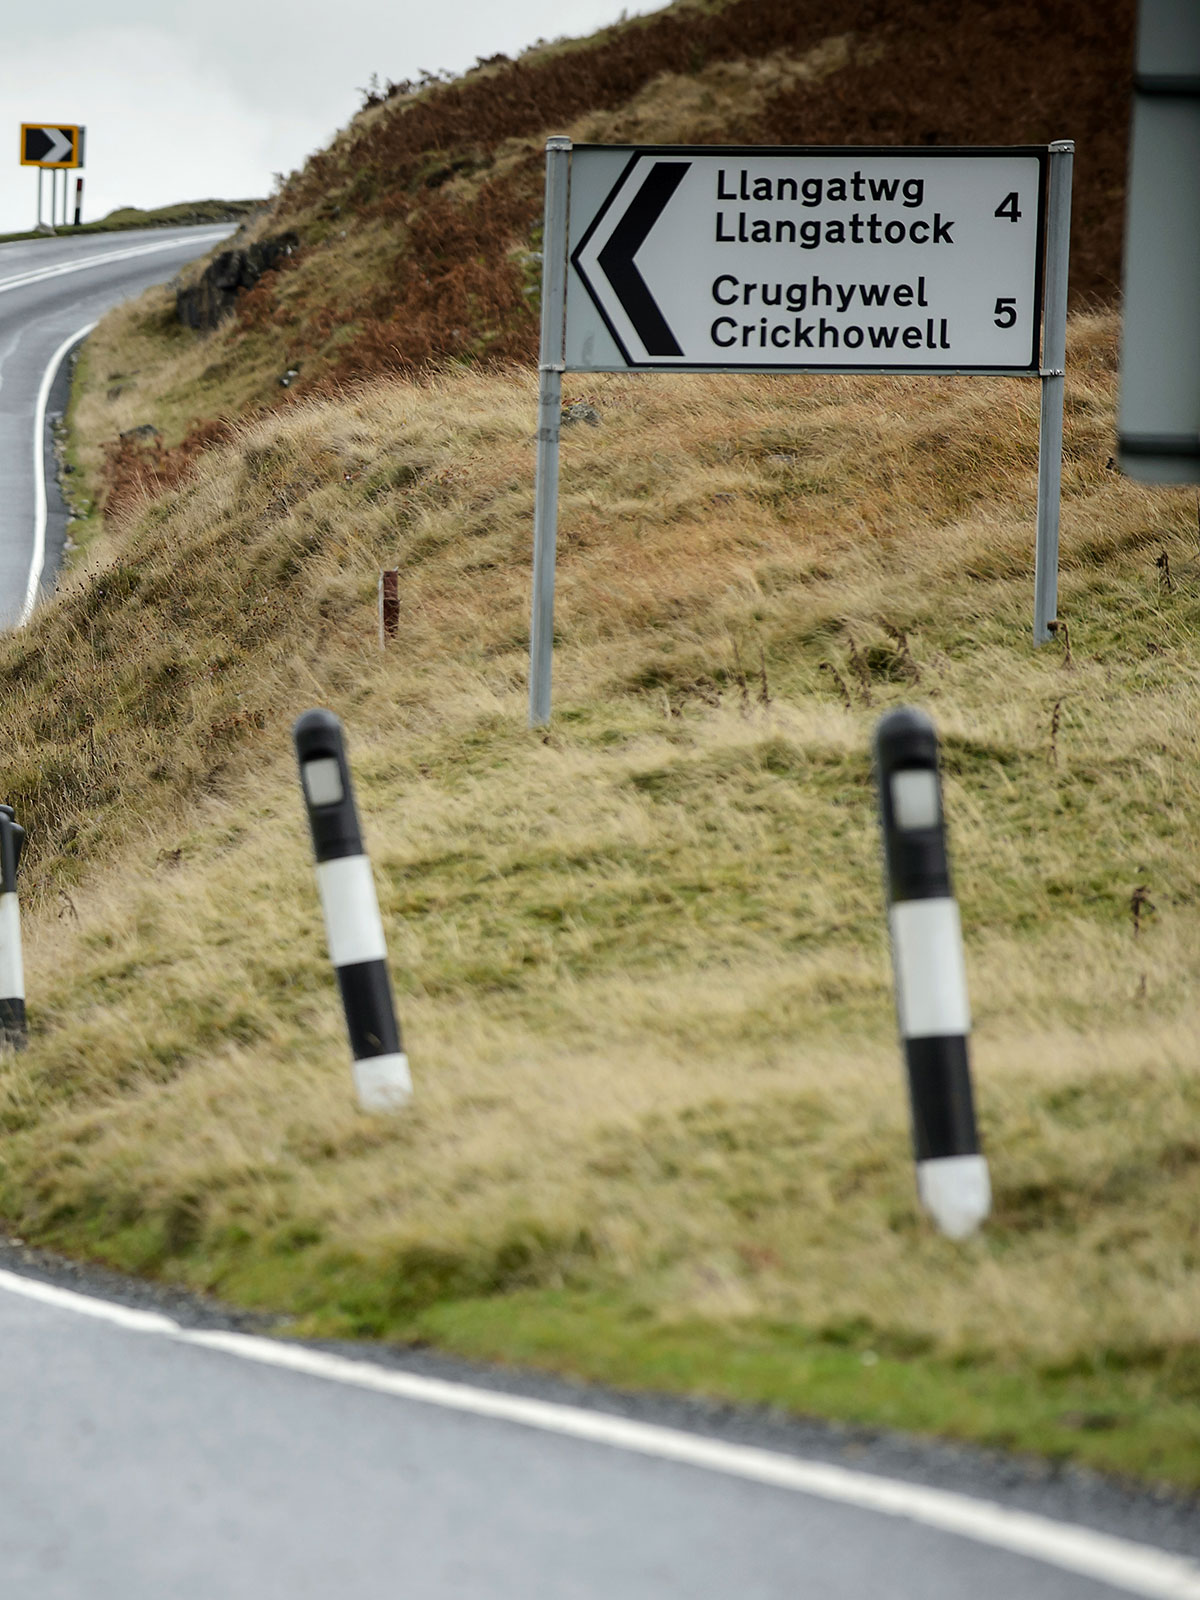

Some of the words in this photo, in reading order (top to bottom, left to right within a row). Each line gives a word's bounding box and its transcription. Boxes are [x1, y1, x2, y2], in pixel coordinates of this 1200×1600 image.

[717, 169, 925, 207] Llangatwg
[993, 191, 1022, 223] 4
[715, 211, 955, 249] Llangattock
[711, 274, 928, 312] Crughywel
[993, 297, 1017, 329] 5
[710, 316, 951, 350] Crickhowell
